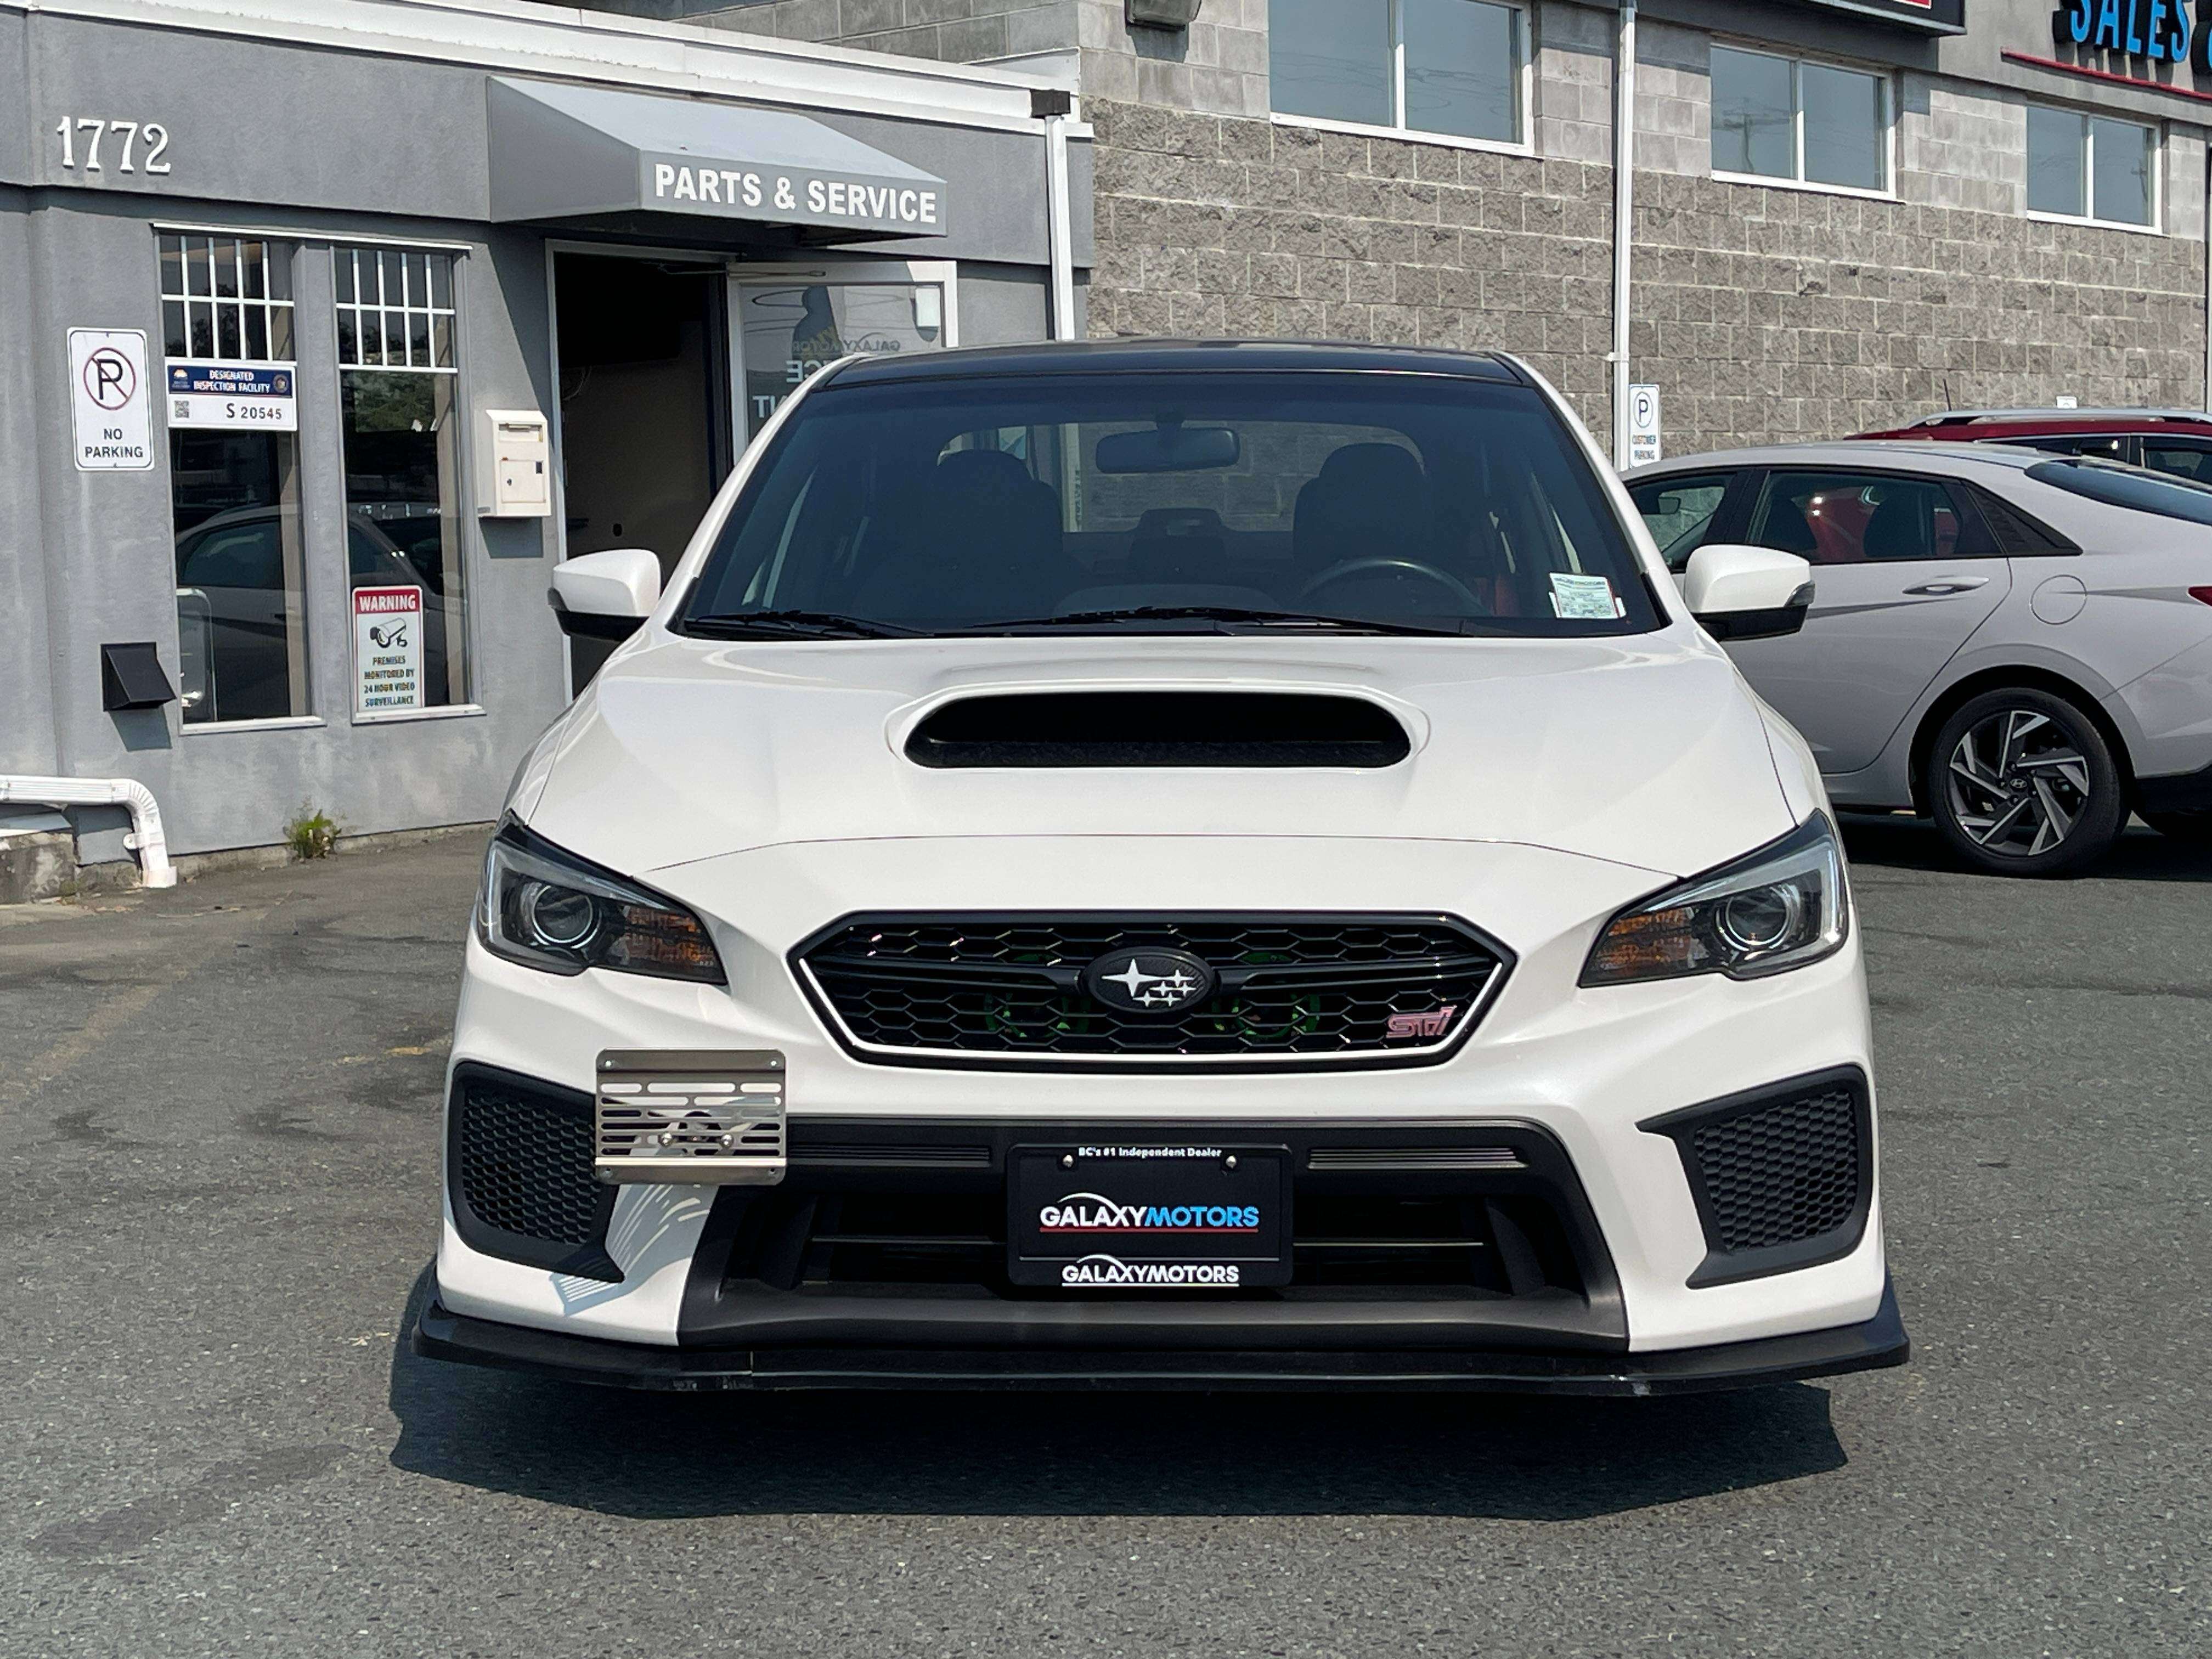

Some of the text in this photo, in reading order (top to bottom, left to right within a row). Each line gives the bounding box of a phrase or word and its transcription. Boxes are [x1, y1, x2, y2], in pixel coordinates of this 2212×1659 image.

[57, 116, 171, 173] 1772
[655, 163, 936, 223] PARTS & SERVICE
[209, 370, 255, 381] DESIGNATED
[193, 380, 236, 392] INSPECTION
[238, 382, 271, 393] FACILITY
[226, 403, 282, 420] S 20545
[1638, 399, 1649, 422] P
[103, 428, 123, 440] NO
[84, 446, 143, 458] PARKING
[359, 594, 416, 612] WARNING
[372, 655, 406, 665] PREMISES
[364, 668, 415, 680] MONITORED BY
[364, 682, 415, 694] 24 HOUR VIDEO
[365, 695, 414, 708] SURVEILLANCE
[1119, 1147, 1186, 1159] Independent
[1187, 1147, 1223, 1157] Dealer
[1062, 1265, 1240, 1283] GALAXYMOTORS
